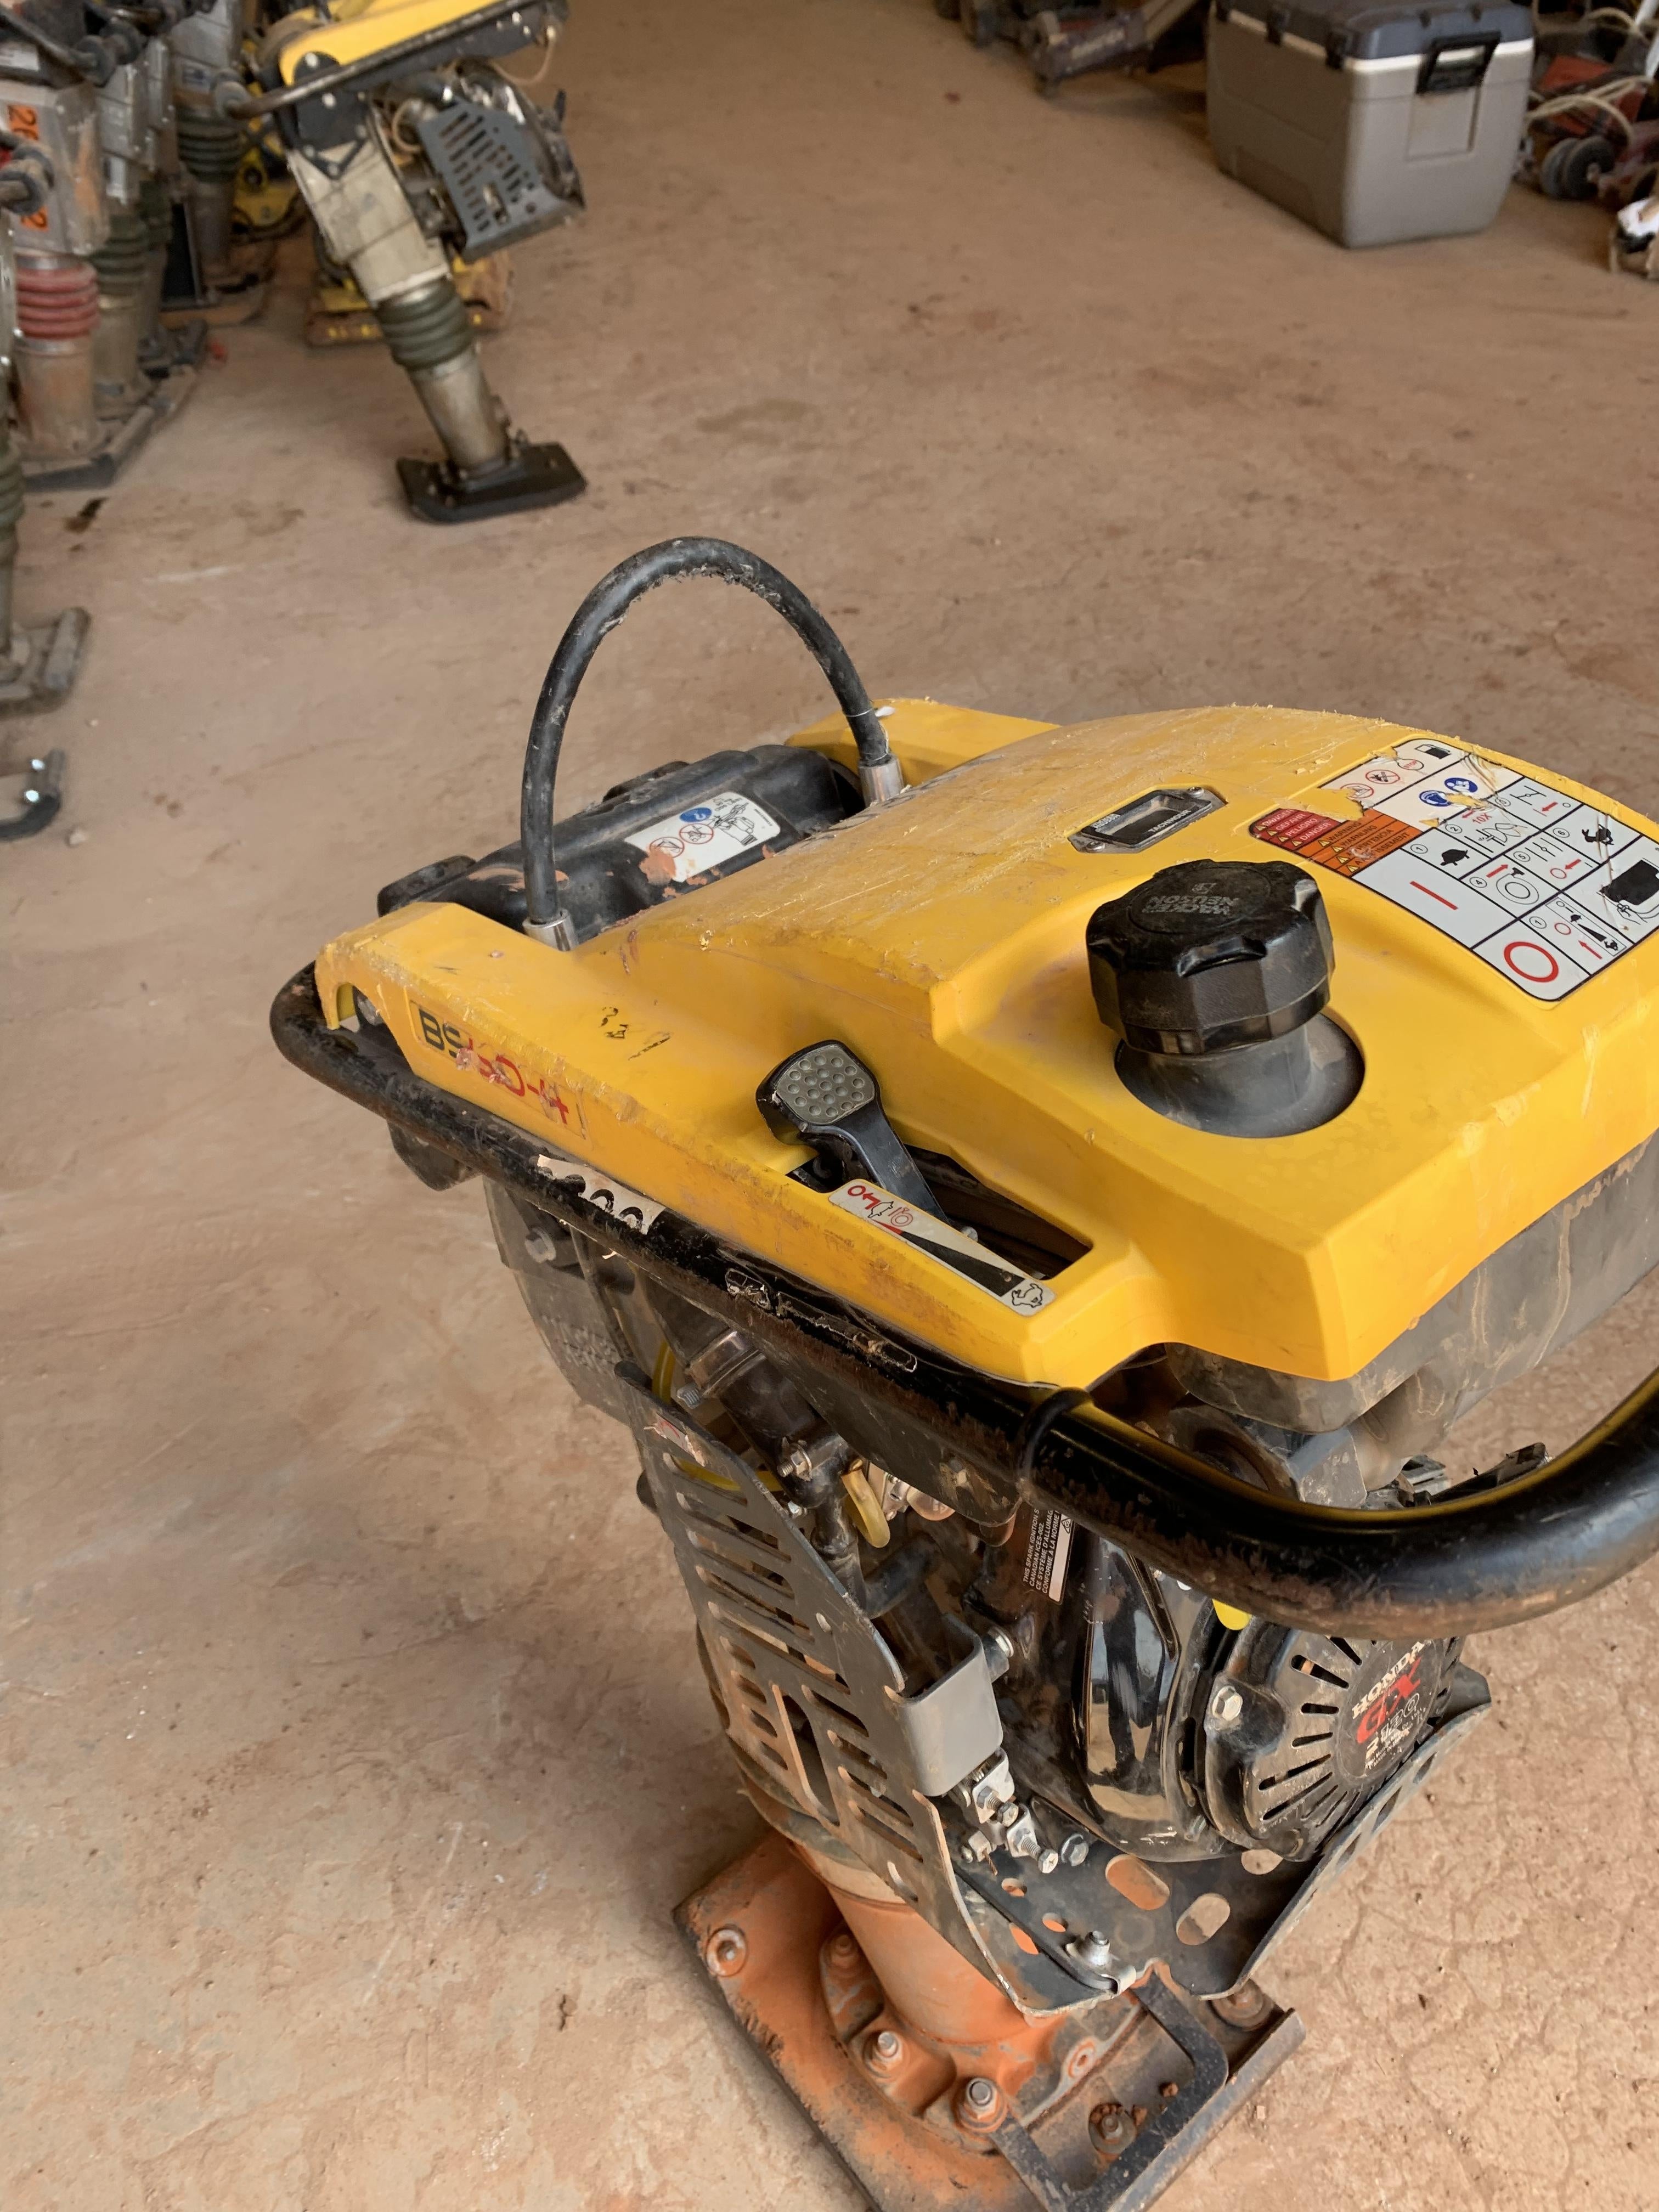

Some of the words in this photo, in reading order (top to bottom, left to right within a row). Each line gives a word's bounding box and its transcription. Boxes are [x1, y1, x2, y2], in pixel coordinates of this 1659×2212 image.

[1276, 814, 1306, 831] GEFAHR
[1285, 818, 1317, 837] PELIGRO
[1472, 812, 1492, 824] 10X
[1299, 822, 1331, 840] DANGER
[1329, 822, 1362, 841] WARNING
[1341, 825, 1378, 847] WARNUNG
[1051, 1513, 1060, 1539] NORME
[1025, 1544, 1034, 1567] SPARK
[1030, 1515, 1039, 1544] IGNITION
[1036, 1579, 1042, 1590] CE
[1042, 1510, 1054, 1548] D'ALLUMAG
[1049, 1540, 1056, 1549] LA
[1029, 1550, 1040, 1587] CANADIAN
[1042, 1556, 1053, 1594] CONFORME
[1352, 1641, 1425, 1719] HONDA
[1356, 1656, 1422, 1744] GX
